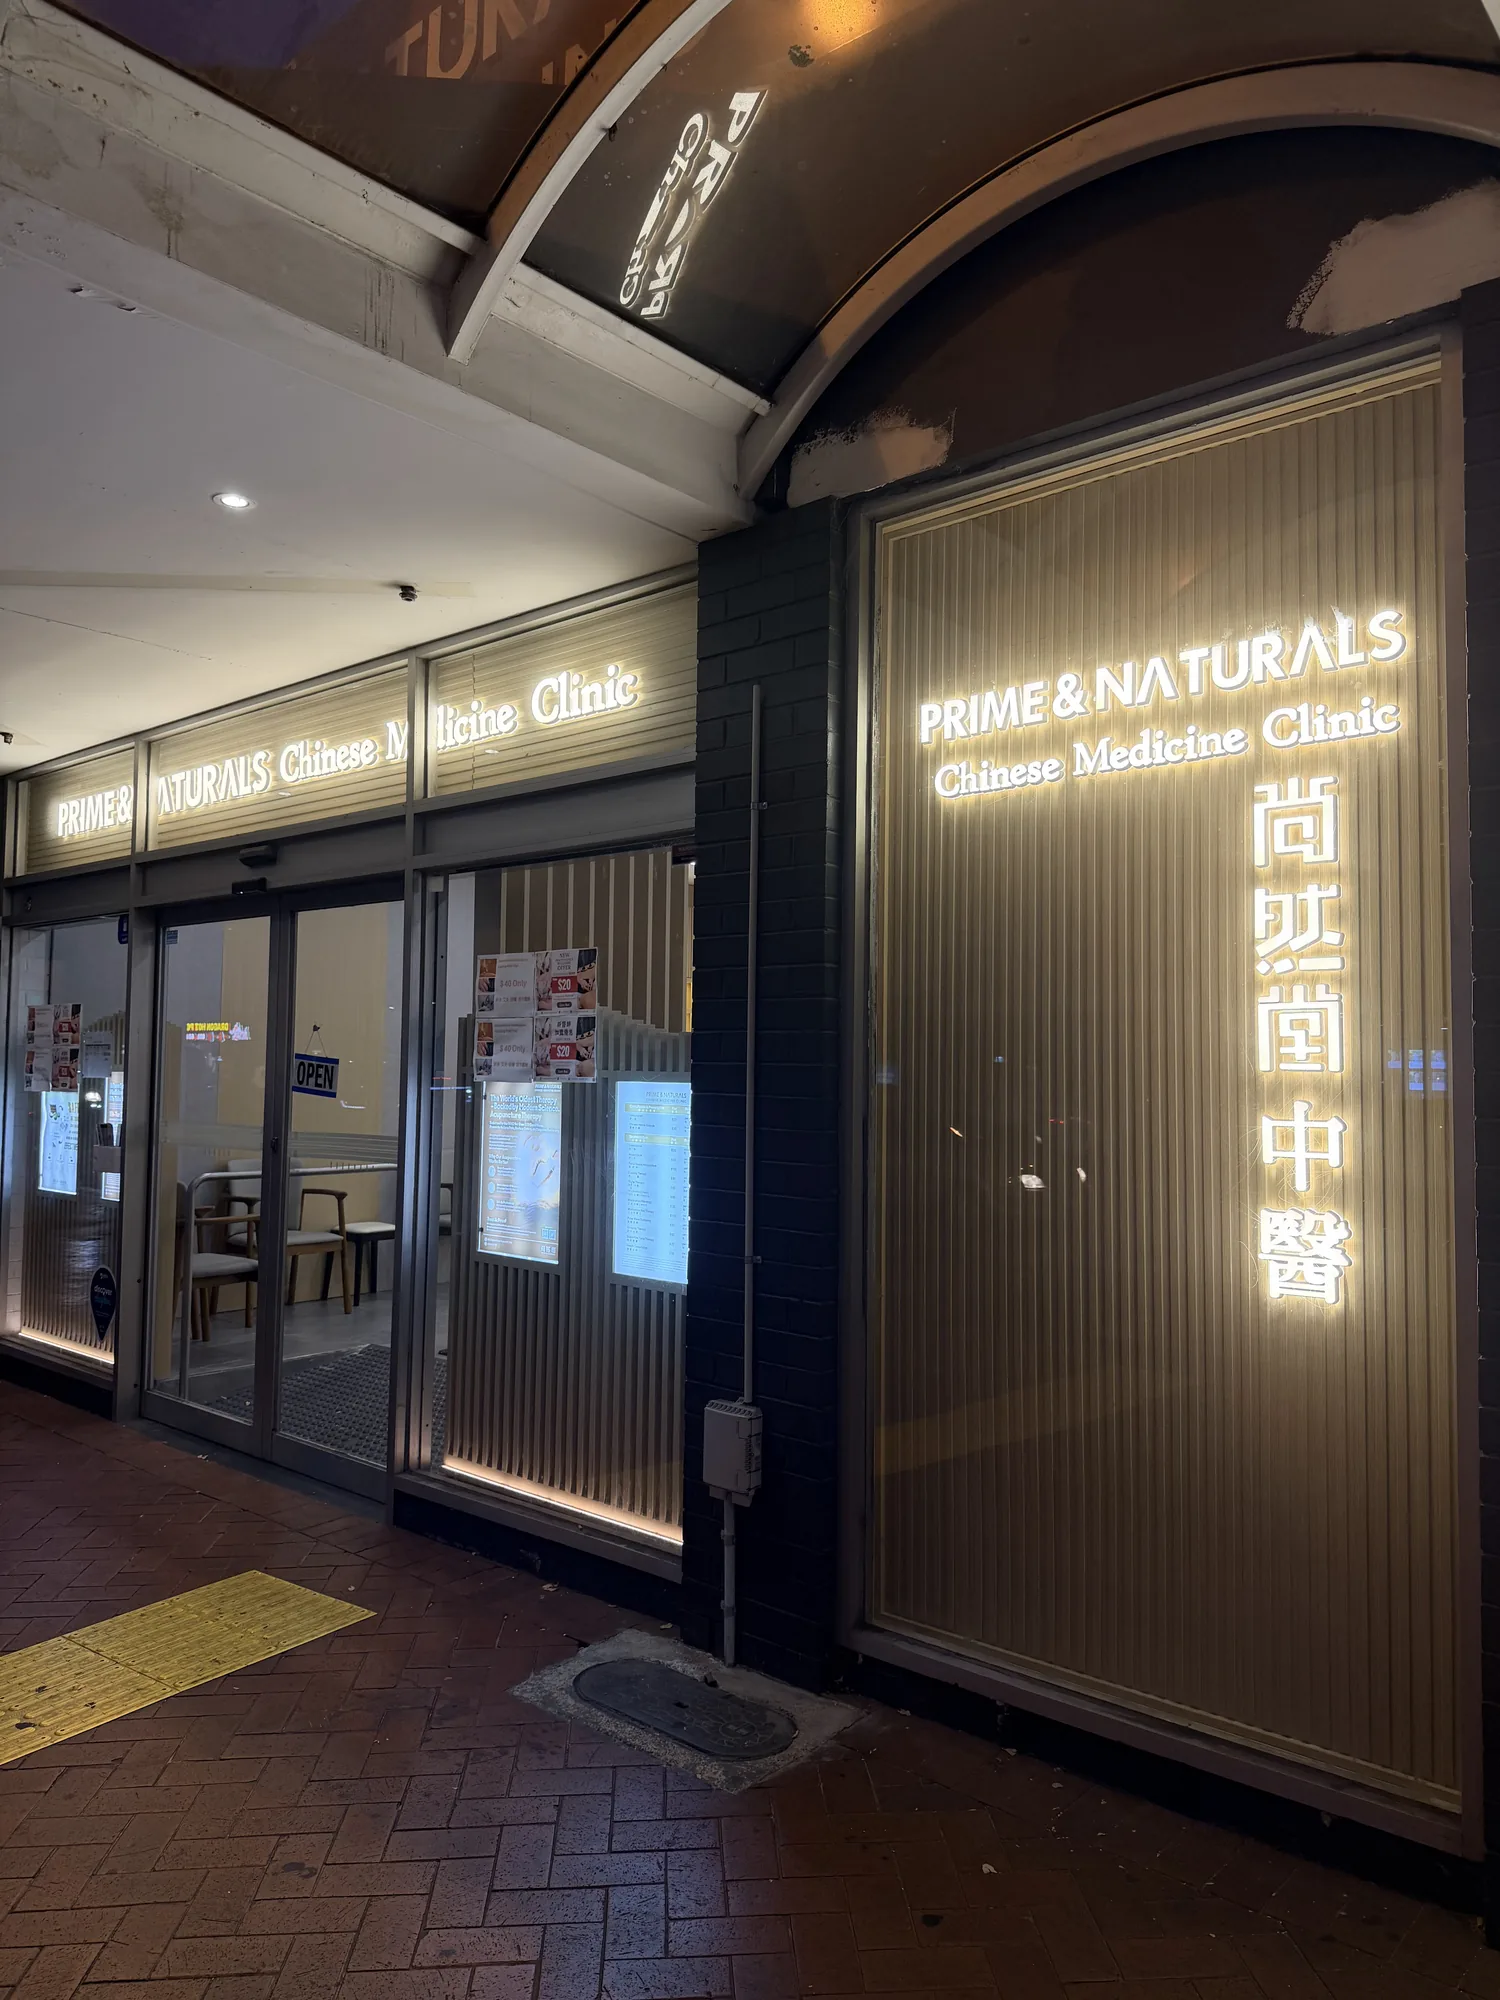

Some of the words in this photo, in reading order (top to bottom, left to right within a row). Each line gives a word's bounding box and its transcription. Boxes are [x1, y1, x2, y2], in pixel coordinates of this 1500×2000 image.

[1093, 604, 1408, 711] NATURALS
[157, 751, 272, 817] ATURALS
[279, 739, 380, 783] Chinese
[531, 664, 639, 725] Clinic
[934, 755, 1064, 799] Chinese
[1072, 724, 1248, 778] Medicine
[1262, 696, 1402, 751] Clinic
[557, 978, 571, 991] $20
[297, 1061, 334, 1090] OPEN
[556, 1045, 570, 1058] $20
